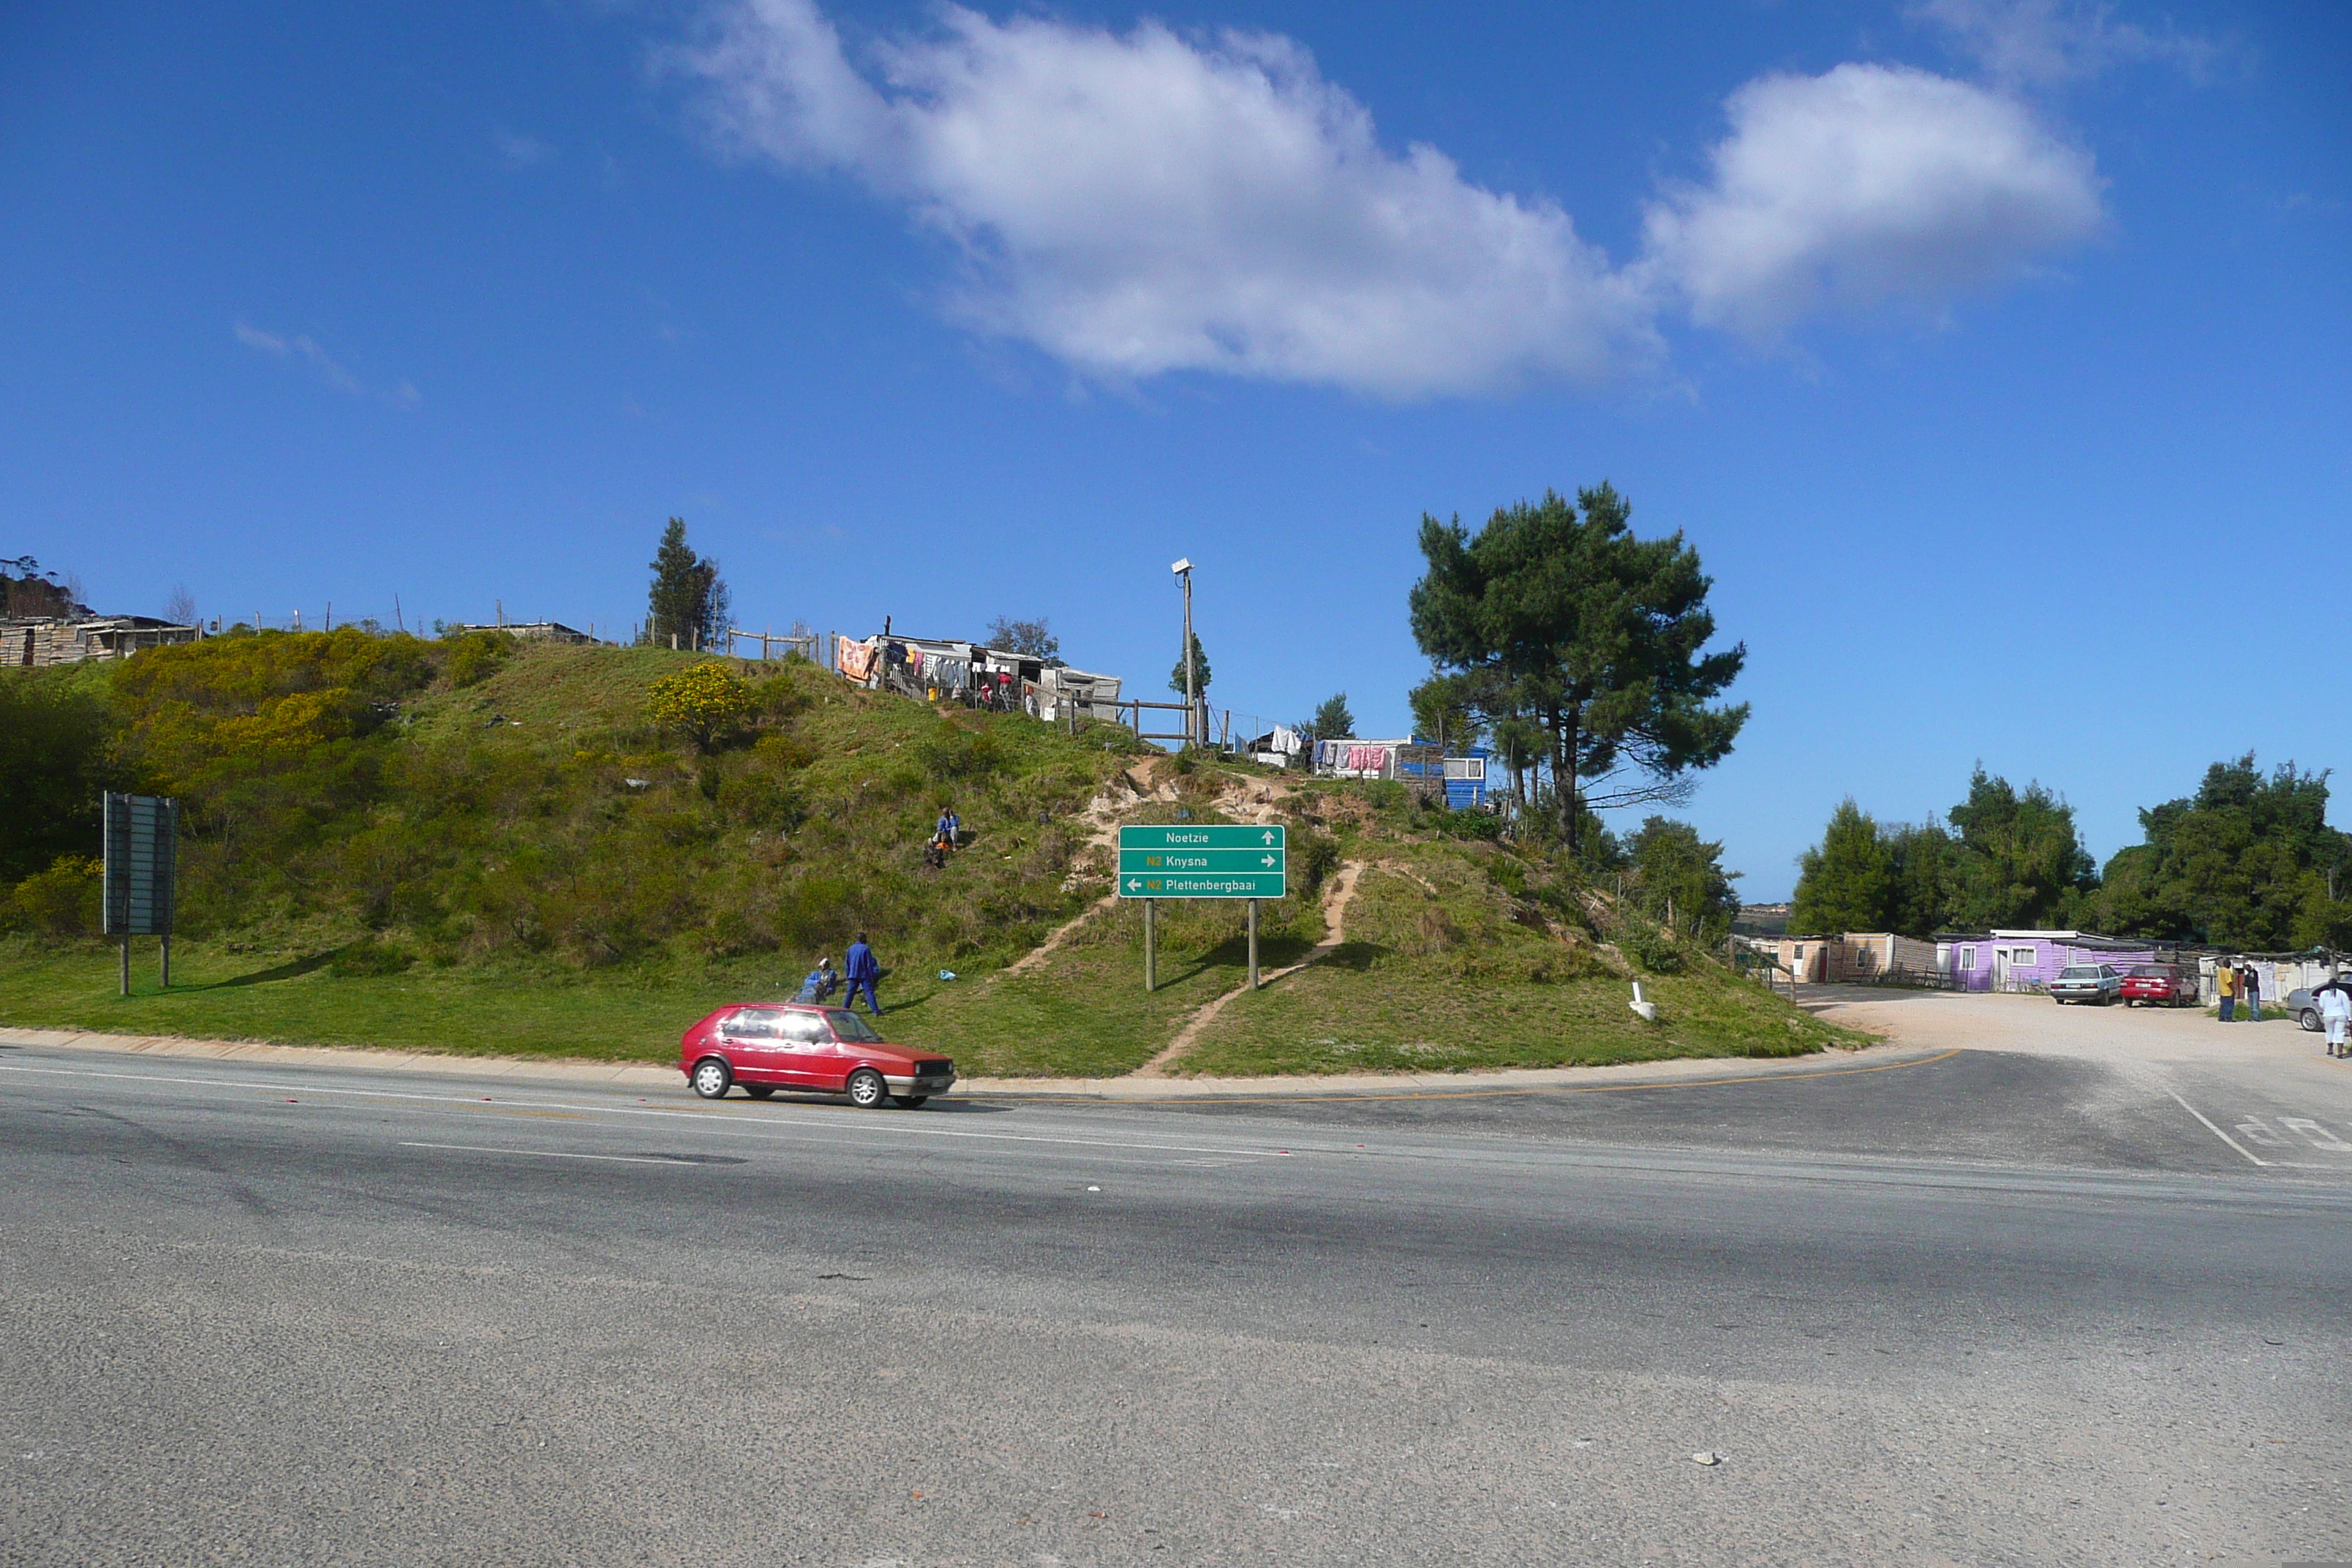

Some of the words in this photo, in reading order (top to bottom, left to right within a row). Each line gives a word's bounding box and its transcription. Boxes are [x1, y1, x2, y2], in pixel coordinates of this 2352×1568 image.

[1166, 832, 1209, 843] Noetzie
[1147, 856, 1162, 867] N2
[1166, 856, 1207, 869] Knysna
[1147, 879, 1162, 890] N2
[1166, 879, 1256, 893] Plettenbergbaai
